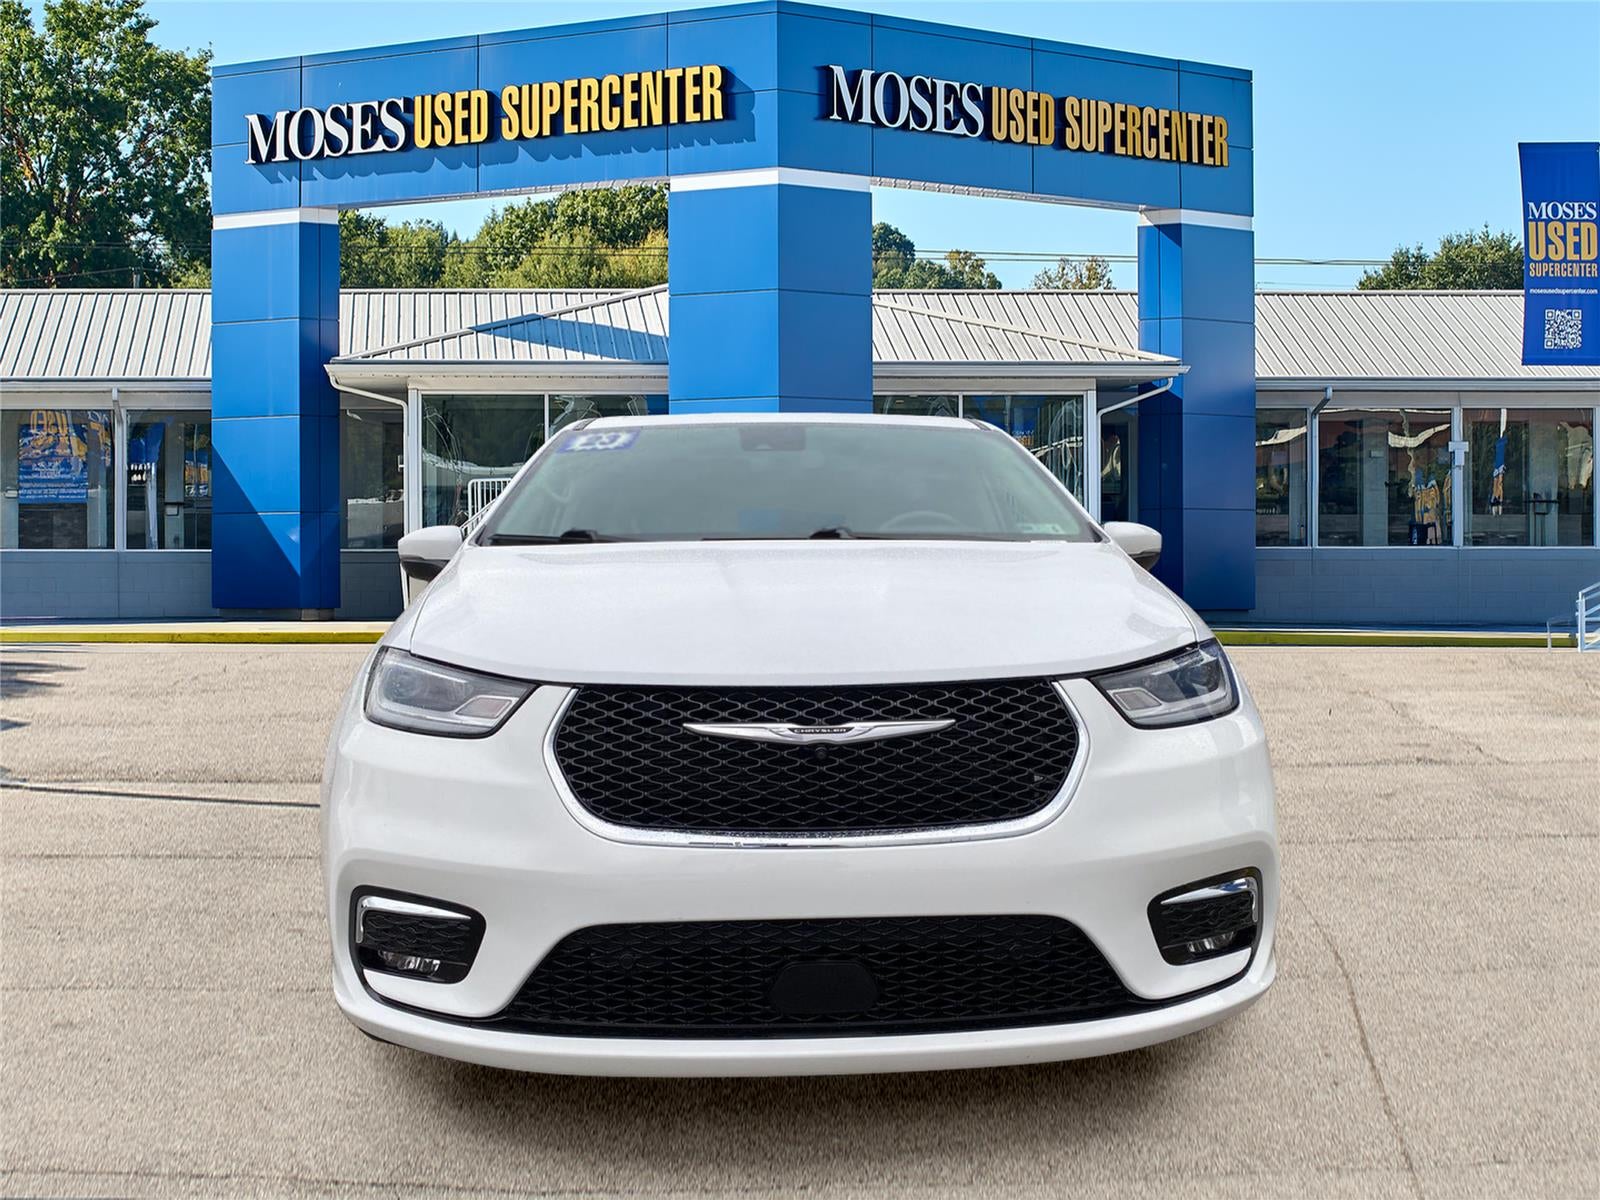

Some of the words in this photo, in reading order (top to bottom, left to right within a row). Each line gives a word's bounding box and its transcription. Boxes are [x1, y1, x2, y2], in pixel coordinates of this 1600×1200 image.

[244, 97, 407, 165] MOSES
[413, 90, 489, 149] USED
[500, 64, 724, 141] SUPERCENTER
[829, 65, 985, 138] MOSES
[991, 87, 1056, 146] USED
[1065, 96, 1229, 167] SUPERCENTER
[1528, 201, 1598, 220] MOSES
[1528, 221, 1598, 261] USED
[1529, 262, 1598, 277] SUPERCENTER
